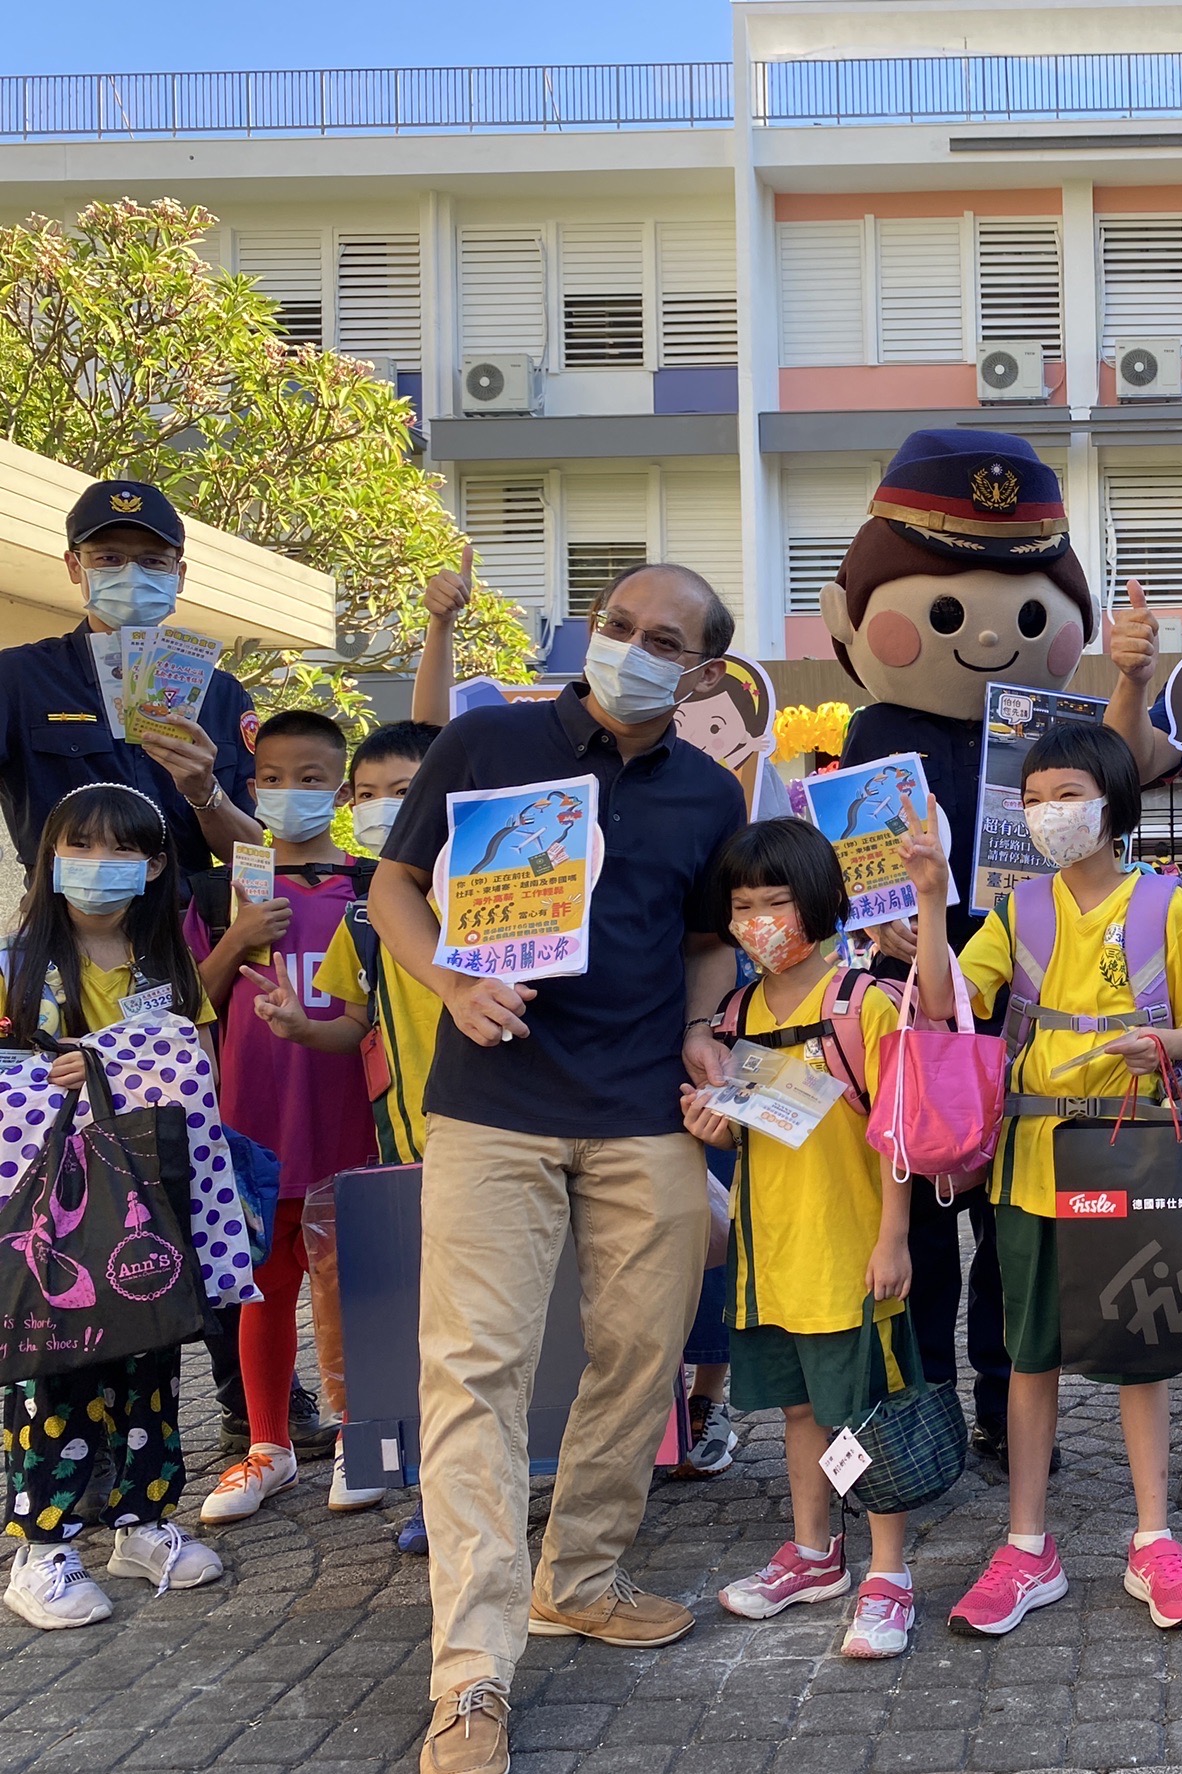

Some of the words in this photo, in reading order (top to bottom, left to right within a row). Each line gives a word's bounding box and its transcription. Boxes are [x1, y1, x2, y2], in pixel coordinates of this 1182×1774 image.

[1003, 697, 1021, 707] 伯伯
[1003, 706, 1029, 718] 您先請
[983, 817, 1032, 838] 超有心
[989, 837, 1031, 852] 行經路口
[472, 892, 514, 907] 海外高薪
[522, 886, 565, 899] 工作輕鬆
[518, 908, 548, 920] 當心有
[551, 902, 572, 918] 詐
[446, 937, 570, 974] 南港分局關心你
[1069, 1193, 1116, 1213] Fissler
[4, 1314, 14, 1329] is
[24, 1312, 57, 1330] short,
[18, 1338, 38, 1352] the
